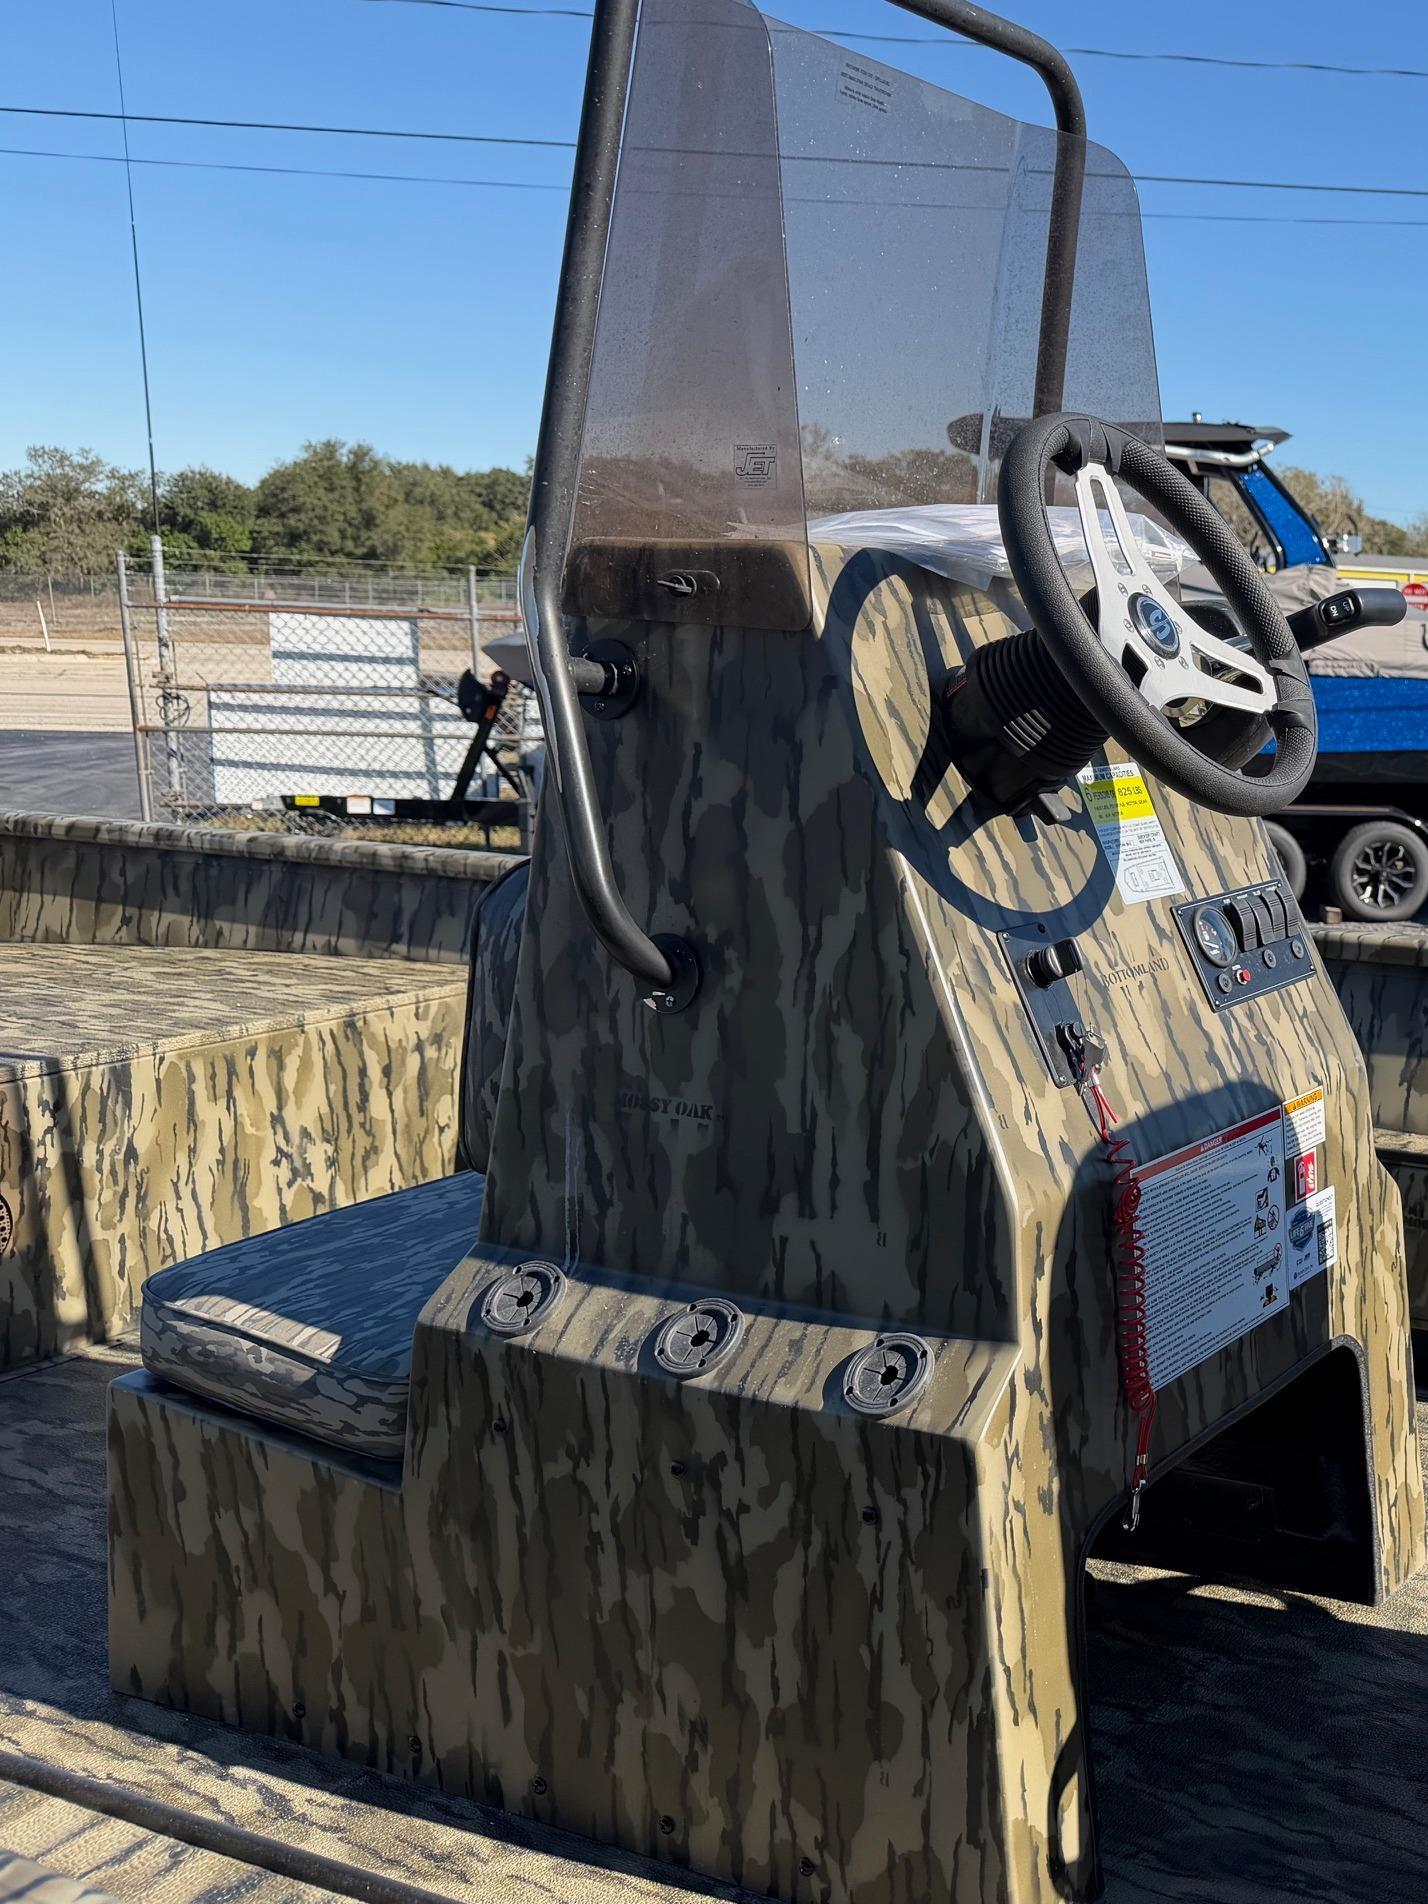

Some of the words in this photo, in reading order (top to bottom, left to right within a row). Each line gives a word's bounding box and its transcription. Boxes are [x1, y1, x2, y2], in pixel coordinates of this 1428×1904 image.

[735, 451, 776, 477] JET
[1330, 605, 1339, 617] DN
[1342, 601, 1351, 612] UP
[1117, 786, 1133, 797] 825
[1101, 957, 1170, 988] BOTTOMLAND
[675, 1100, 714, 1121] OAK
[1204, 1136, 1223, 1151] DANGER
